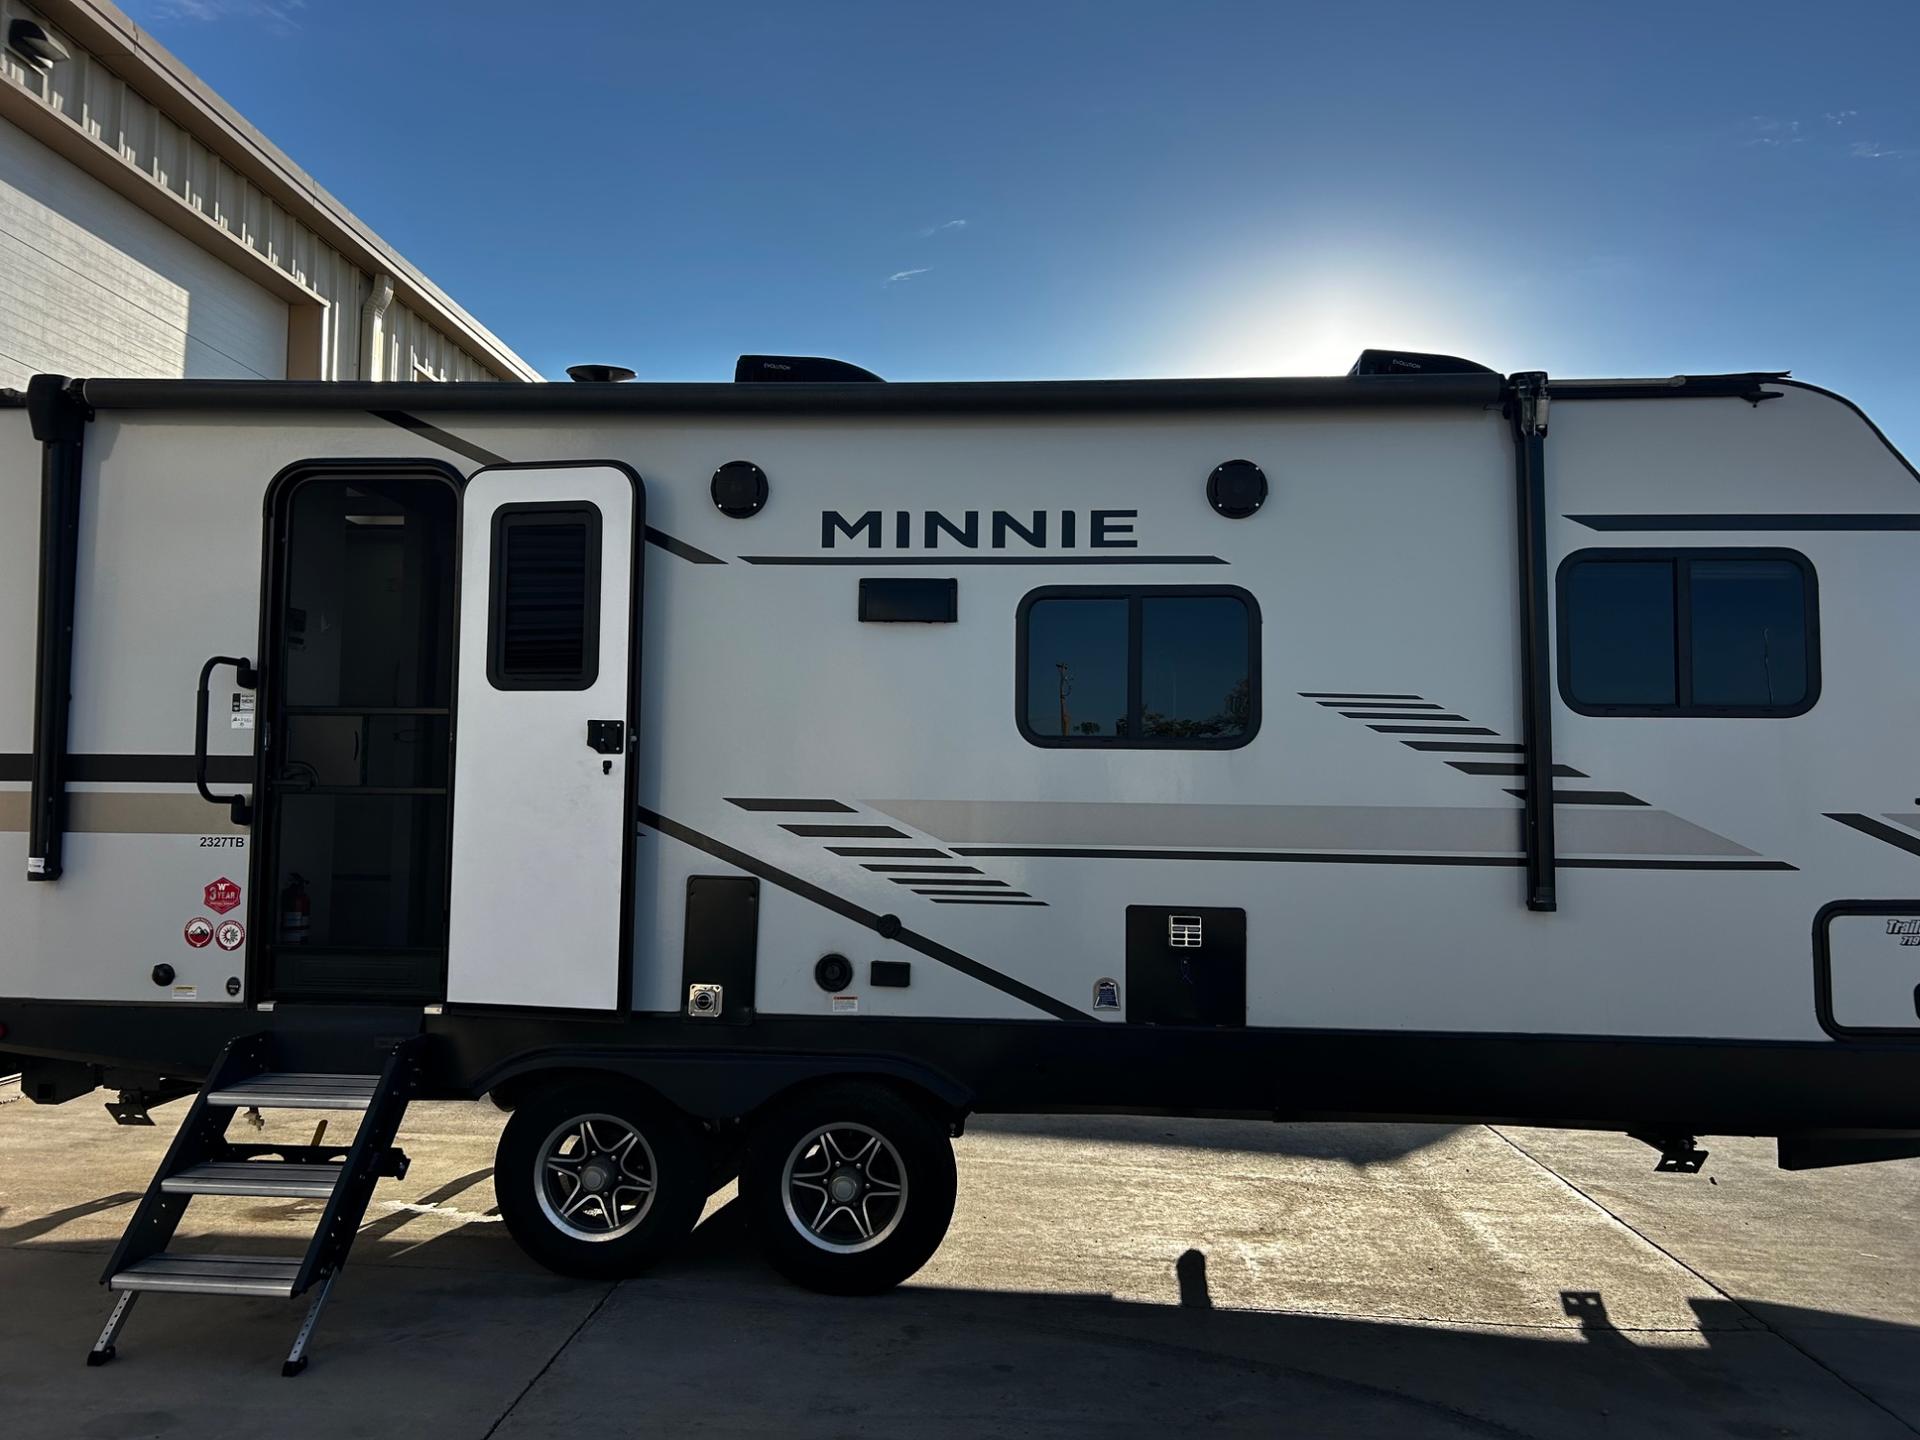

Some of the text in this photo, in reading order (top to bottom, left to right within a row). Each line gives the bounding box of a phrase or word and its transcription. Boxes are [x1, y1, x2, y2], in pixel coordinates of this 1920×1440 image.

[821, 509, 1138, 549] MINNIE
[200, 836, 245, 848] 2327TB
[209, 887, 236, 901] 3 YEAR
[1886, 918, 1920, 935] Trail
